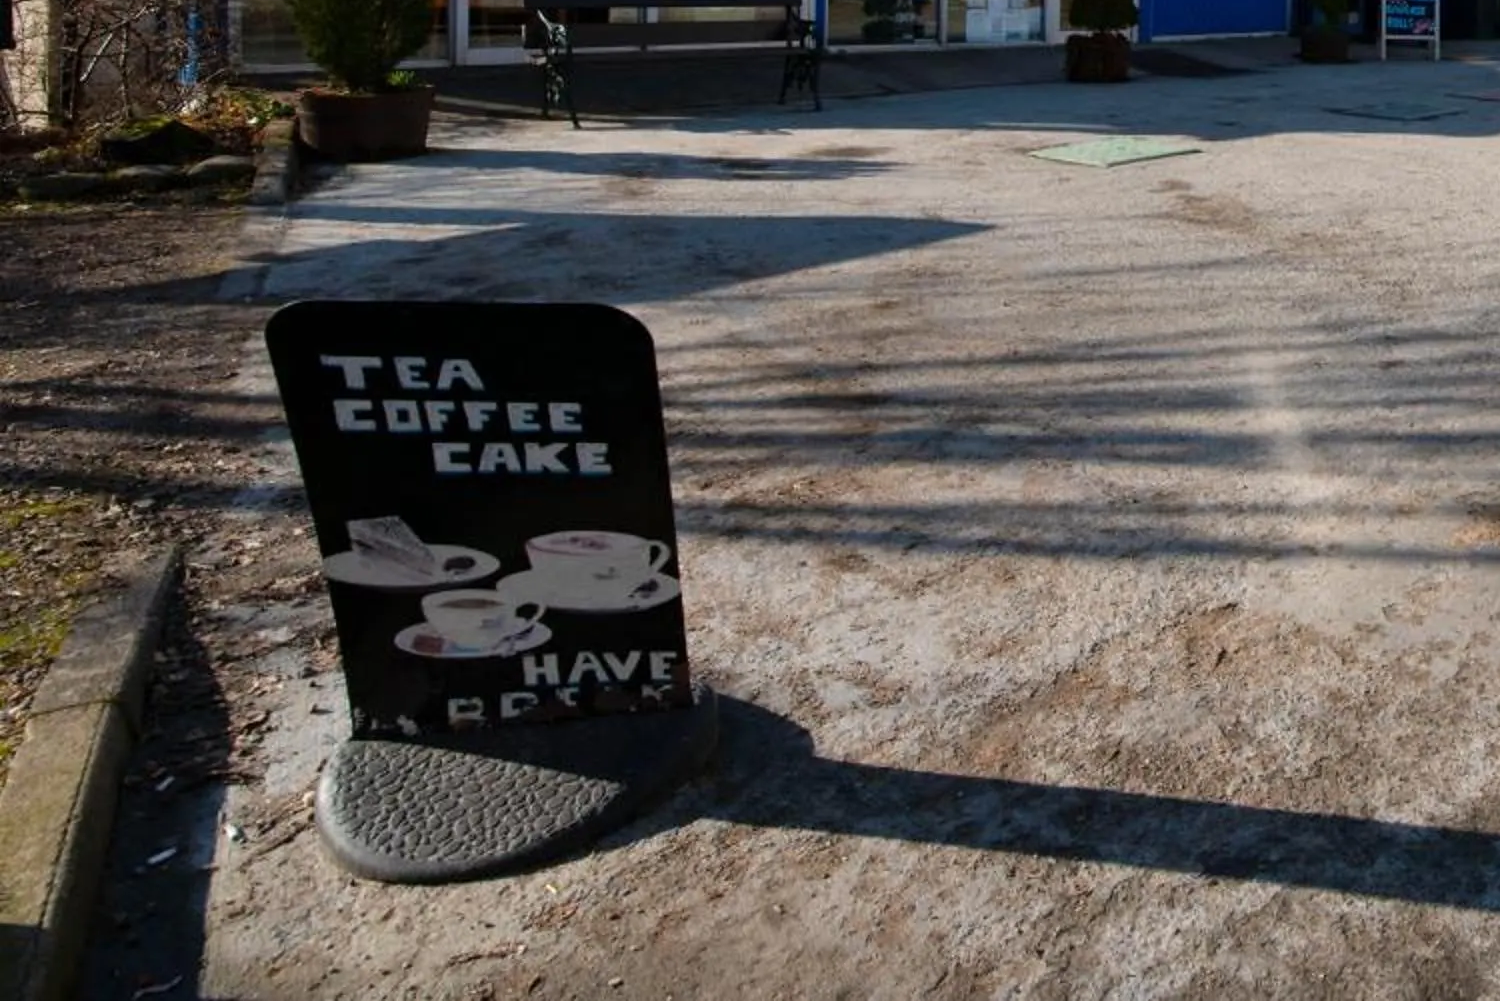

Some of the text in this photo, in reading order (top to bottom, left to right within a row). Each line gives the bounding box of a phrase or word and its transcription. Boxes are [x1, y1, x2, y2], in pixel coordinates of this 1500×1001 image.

[320, 355, 485, 390] TEA
[333, 400, 583, 432] COFFEE
[431, 442, 612, 473] CAKE
[522, 651, 678, 686] HAVE
